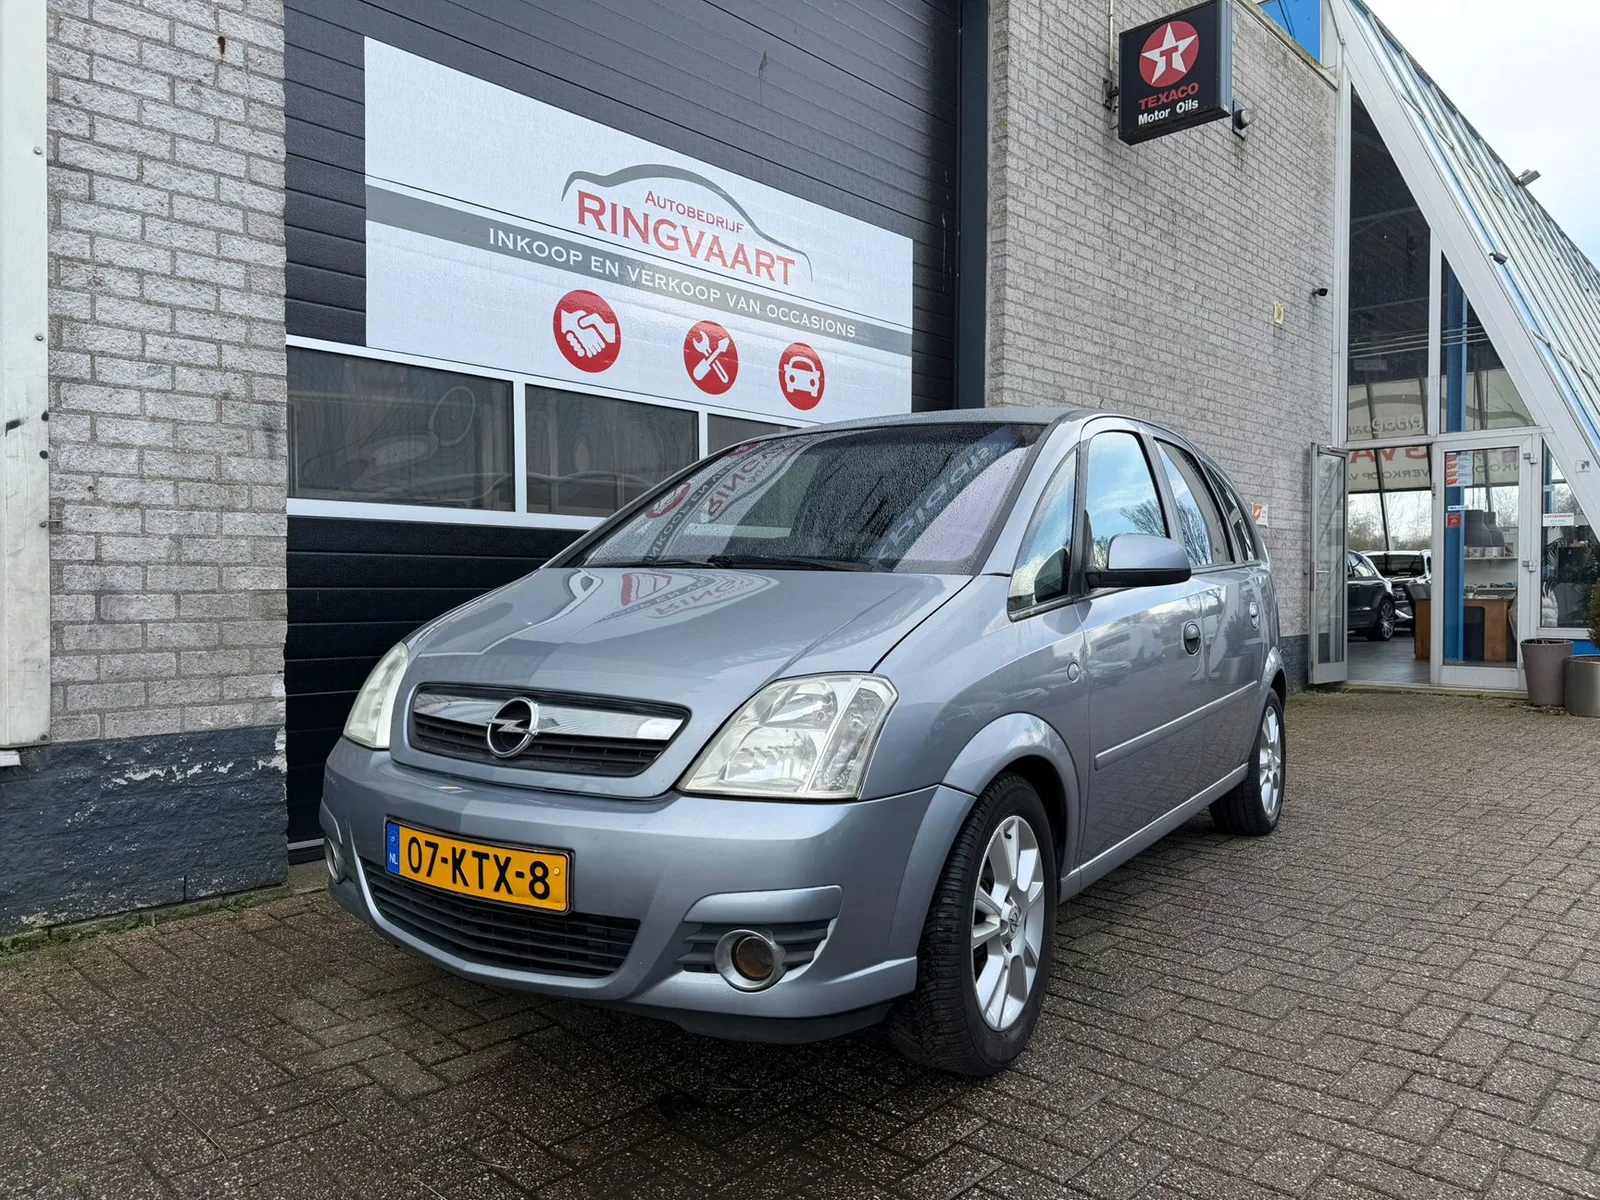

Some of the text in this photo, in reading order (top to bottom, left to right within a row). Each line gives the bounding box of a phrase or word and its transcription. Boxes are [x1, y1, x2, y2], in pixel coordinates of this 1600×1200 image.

[1138, 82, 1199, 110] TEXACO
[1138, 99, 1199, 125] Motor Oils
[644, 190, 744, 234] AUTOBEDRIJF
[577, 189, 795, 286] RINGVAART
[489, 227, 856, 338] INKOOP EN VERKOOP VAN OCCASIONS
[389, 852, 398, 866] NL
[407, 836, 550, 900] 07-KTX-8
